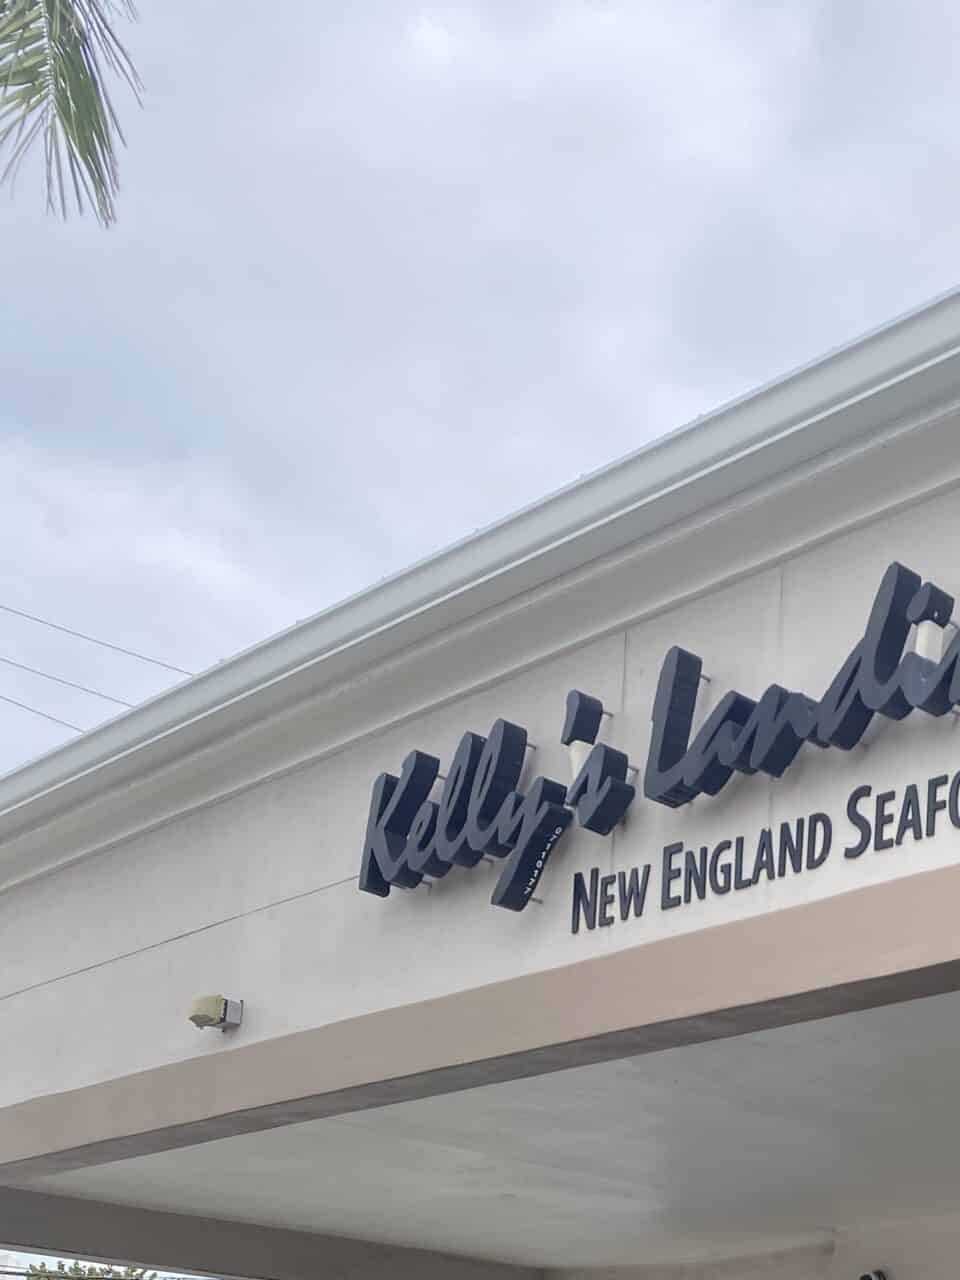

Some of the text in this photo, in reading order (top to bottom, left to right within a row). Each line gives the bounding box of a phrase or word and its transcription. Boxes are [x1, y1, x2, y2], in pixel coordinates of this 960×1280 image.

[358, 689, 634, 912] Kelly's
[571, 864, 651, 934] NEW
[661, 812, 832, 910] ENGLAND
